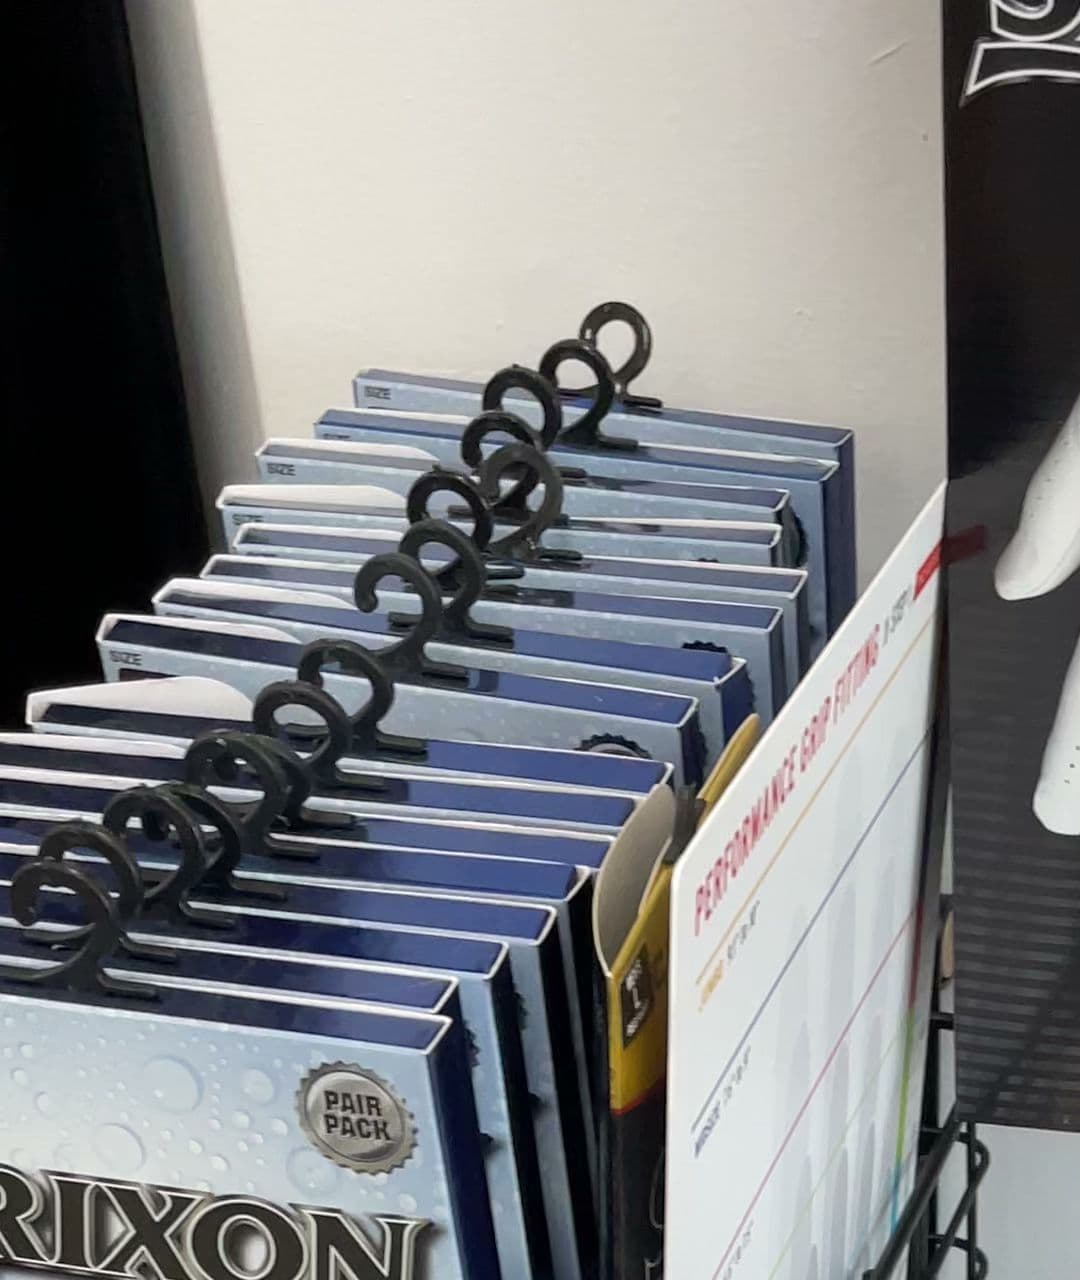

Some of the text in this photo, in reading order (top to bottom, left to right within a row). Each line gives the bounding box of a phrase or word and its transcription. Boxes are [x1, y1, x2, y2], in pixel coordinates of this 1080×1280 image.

[110, 650, 142, 666] SIZE
[323, 1088, 383, 1118] PAIR
[323, 1112, 392, 1142] PACK
